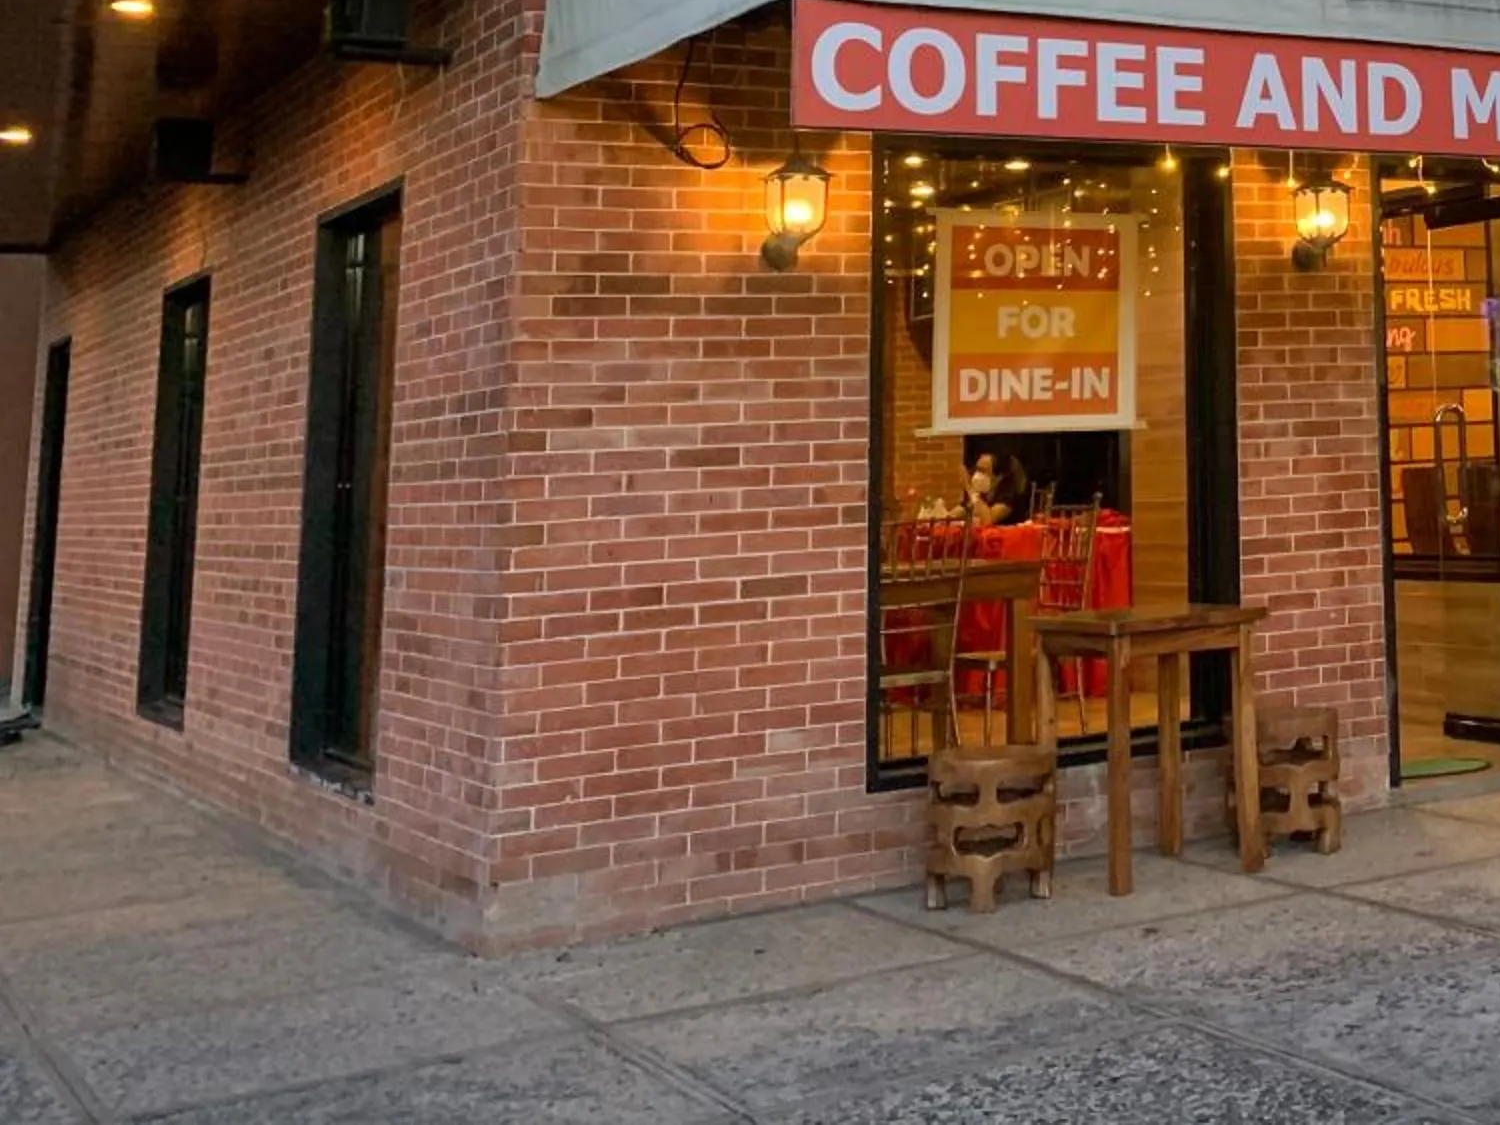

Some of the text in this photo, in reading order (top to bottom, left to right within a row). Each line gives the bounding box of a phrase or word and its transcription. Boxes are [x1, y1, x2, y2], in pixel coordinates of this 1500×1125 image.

[811, 21, 1206, 127] COFFEE
[1235, 52, 1422, 136] AND
[983, 242, 1091, 278] OPEN
[1390, 288, 1472, 312] FRESH
[997, 304, 1076, 340] FOR
[958, 366, 1111, 403] DINE-IN
